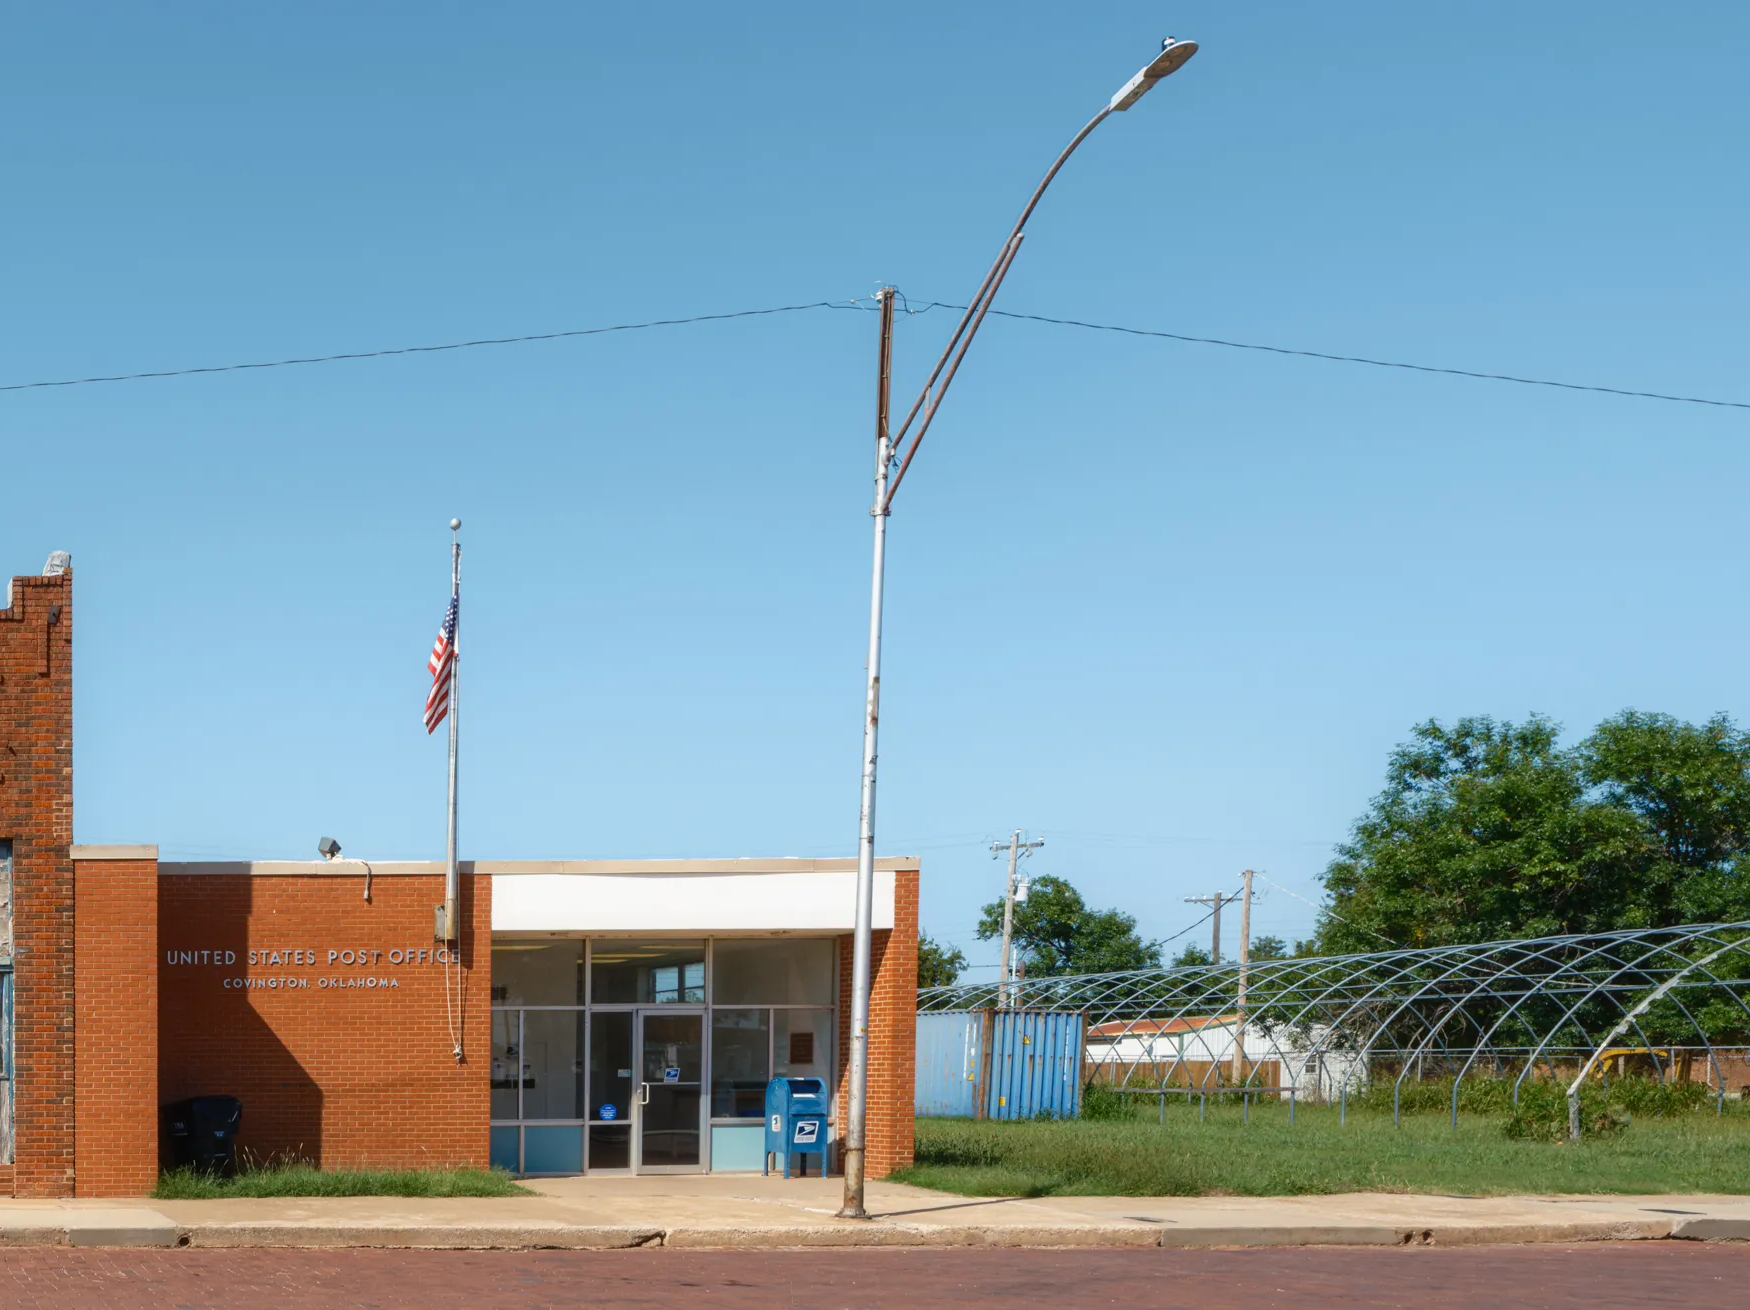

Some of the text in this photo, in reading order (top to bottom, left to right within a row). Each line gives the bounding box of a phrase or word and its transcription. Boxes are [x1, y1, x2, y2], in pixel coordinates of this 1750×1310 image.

[167, 949, 460, 965] UNITED STATES POST OFFICE
[318, 977, 399, 988] OKLAHOMA
